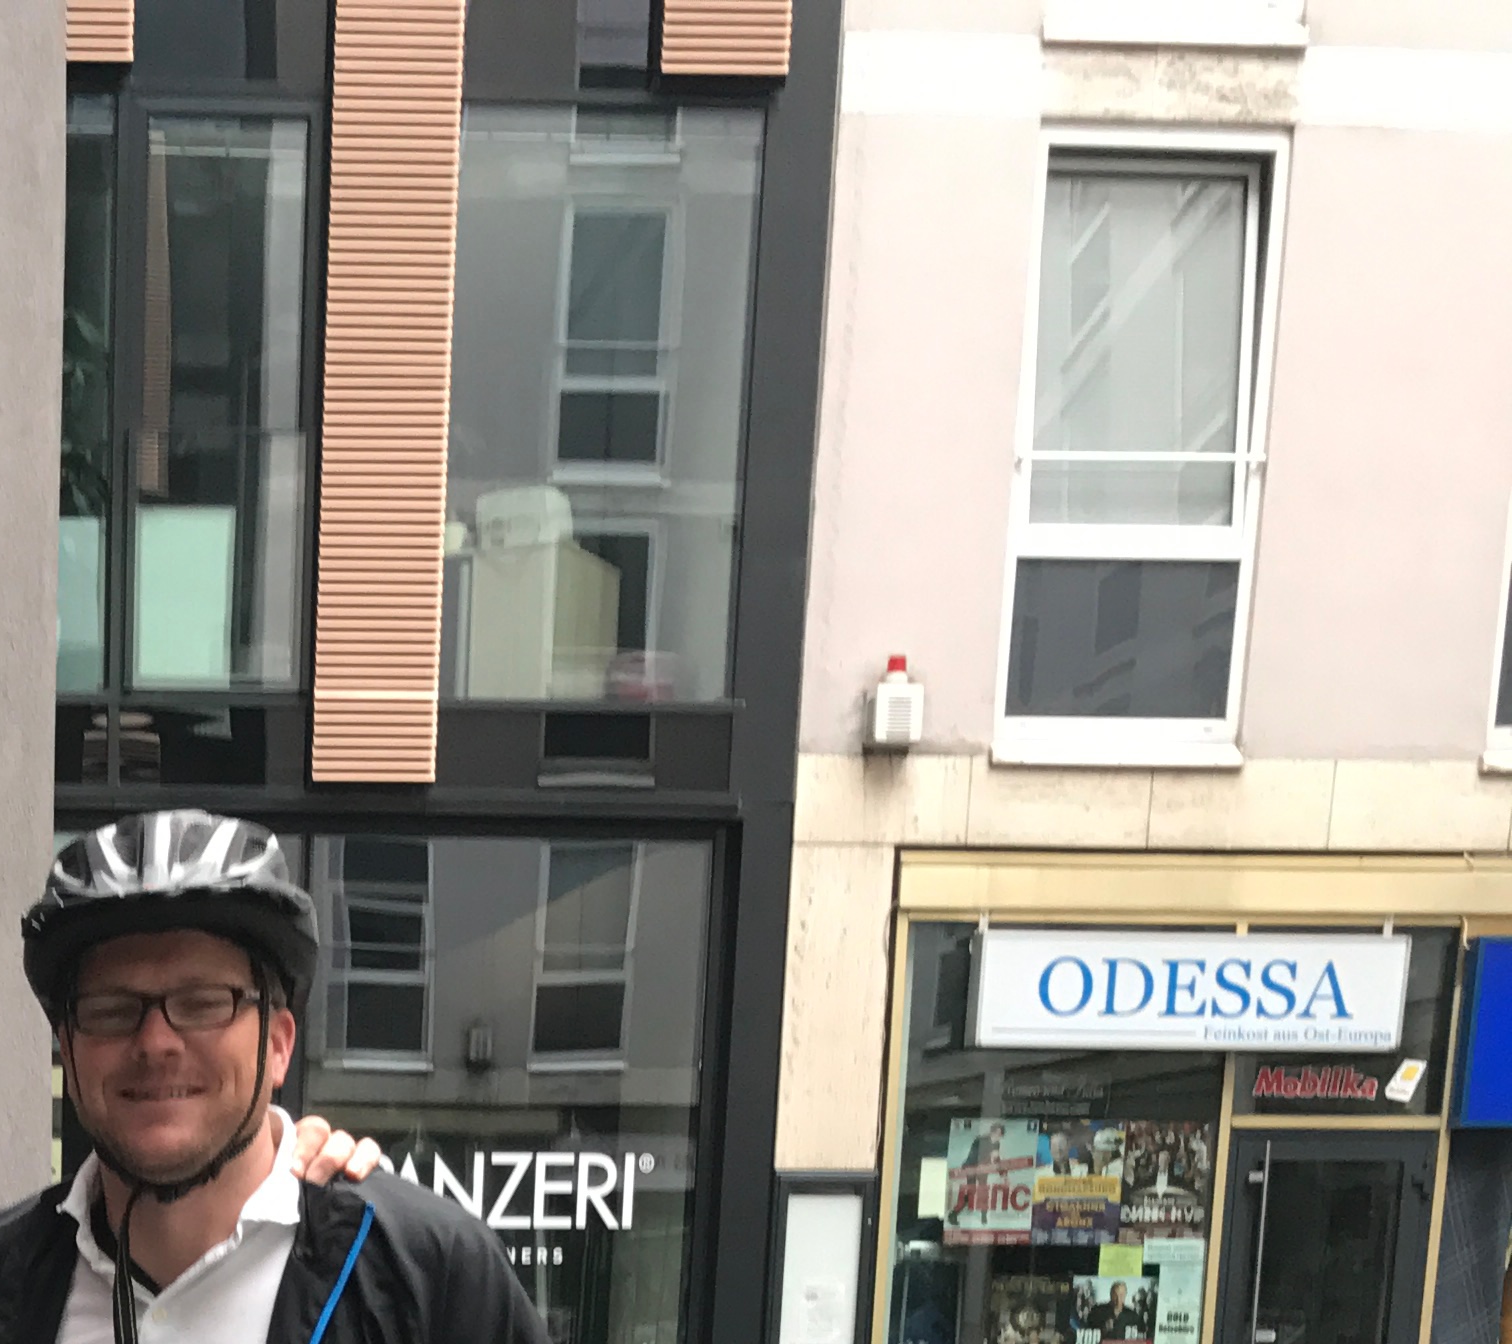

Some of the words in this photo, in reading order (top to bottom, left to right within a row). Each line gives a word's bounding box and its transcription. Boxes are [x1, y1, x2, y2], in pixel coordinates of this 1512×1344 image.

[1038, 955, 1353, 1020] ODESSA
[1204, 1026, 1268, 1042] Feinkost
[1273, 1029, 1298, 1042] aus
[1304, 1026, 1392, 1046] Ost-Europa
[1252, 1065, 1379, 1101] Mobilka
